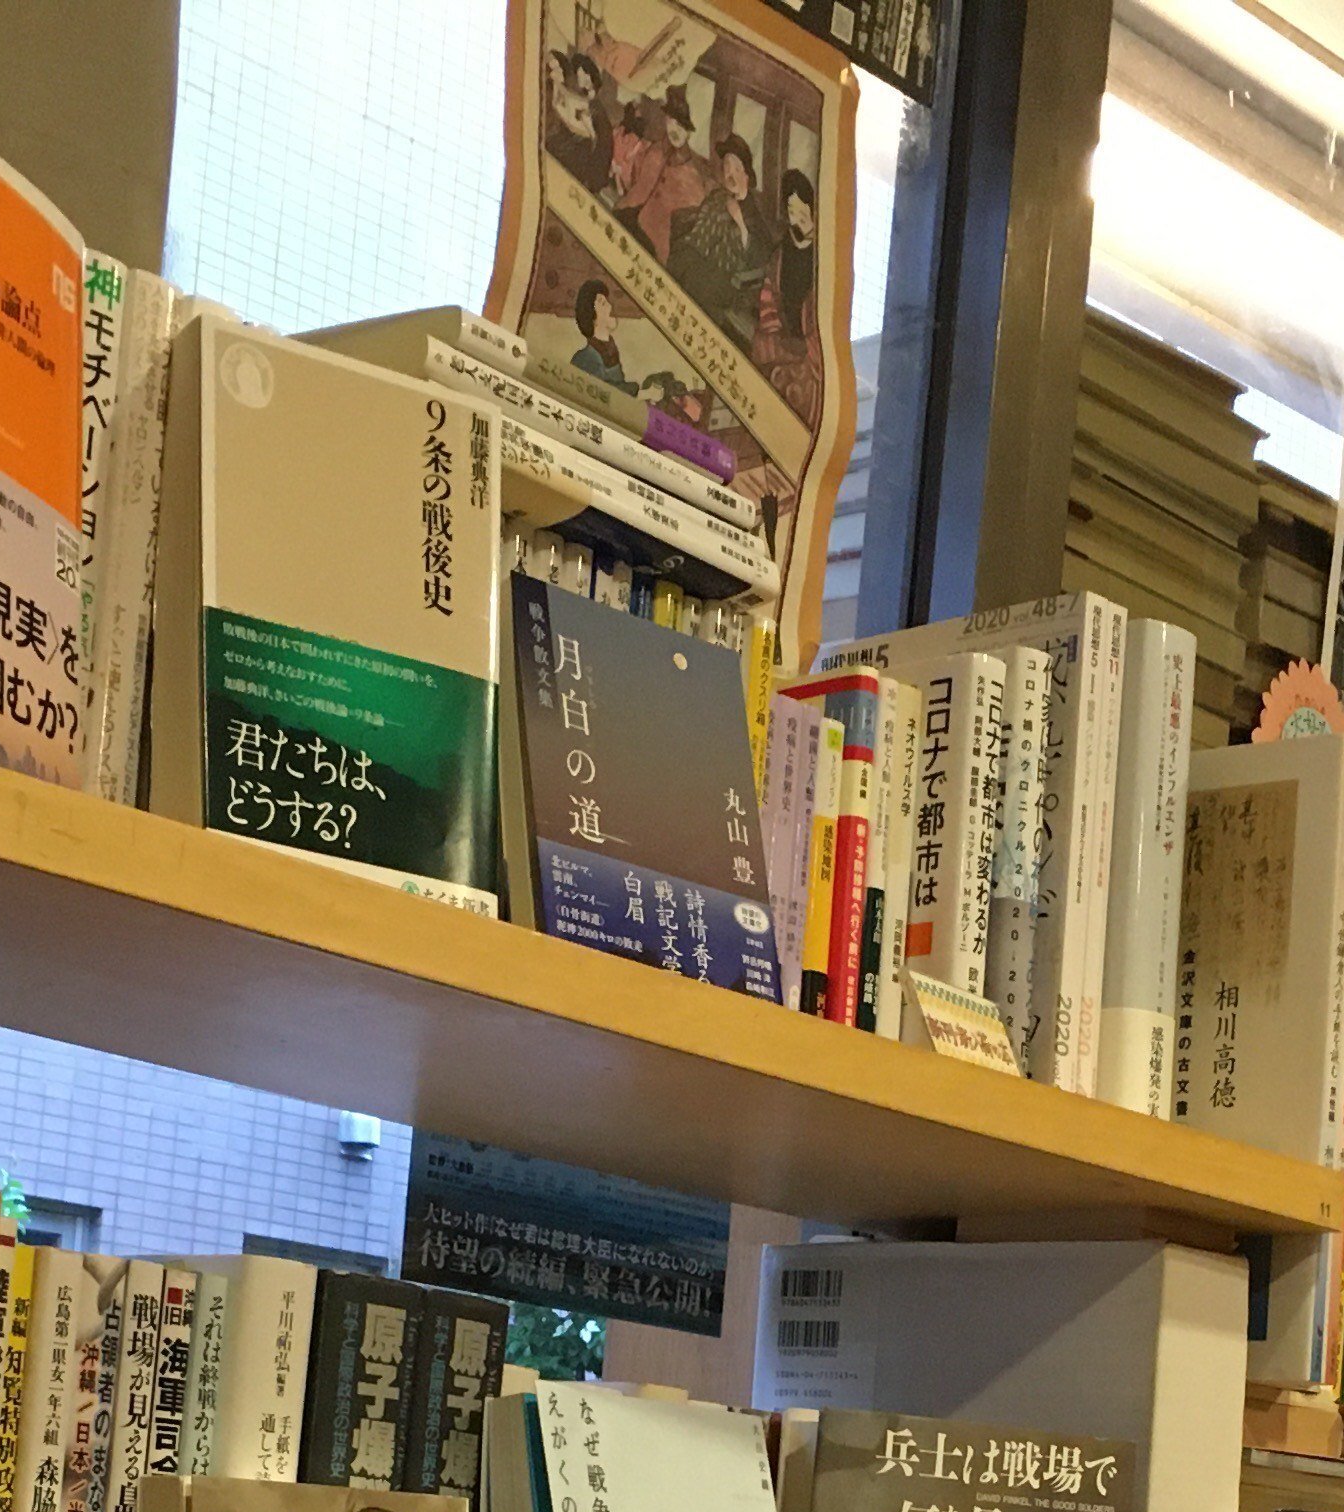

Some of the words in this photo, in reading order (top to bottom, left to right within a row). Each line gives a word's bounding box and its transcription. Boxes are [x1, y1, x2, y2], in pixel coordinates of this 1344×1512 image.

[419, 397, 455, 617] 9条の戦後史
[468, 411, 491, 511] 加藤典洋
[963, 603, 1011, 636] 2020
[224, 718, 388, 802] 君たちは、
[555, 633, 606, 845] 月白の道
[225, 776, 358, 850] どうする?
[914, 675, 954, 909] コロナで都市は
[972, 679, 1005, 955] コロナで都市は変わるか
[623, 871, 646, 926] 白眉
[1175, 949, 1197, 1118] 金沢文庫の古文書
[1208, 980, 1241, 1109] 相川高徳
[418, 1227, 714, 1319] 待望の続編、緊急公開!
[274, 1290, 296, 1373] 平川祐弘
[875, 1428, 1118, 1497] 兵士は戦場で
